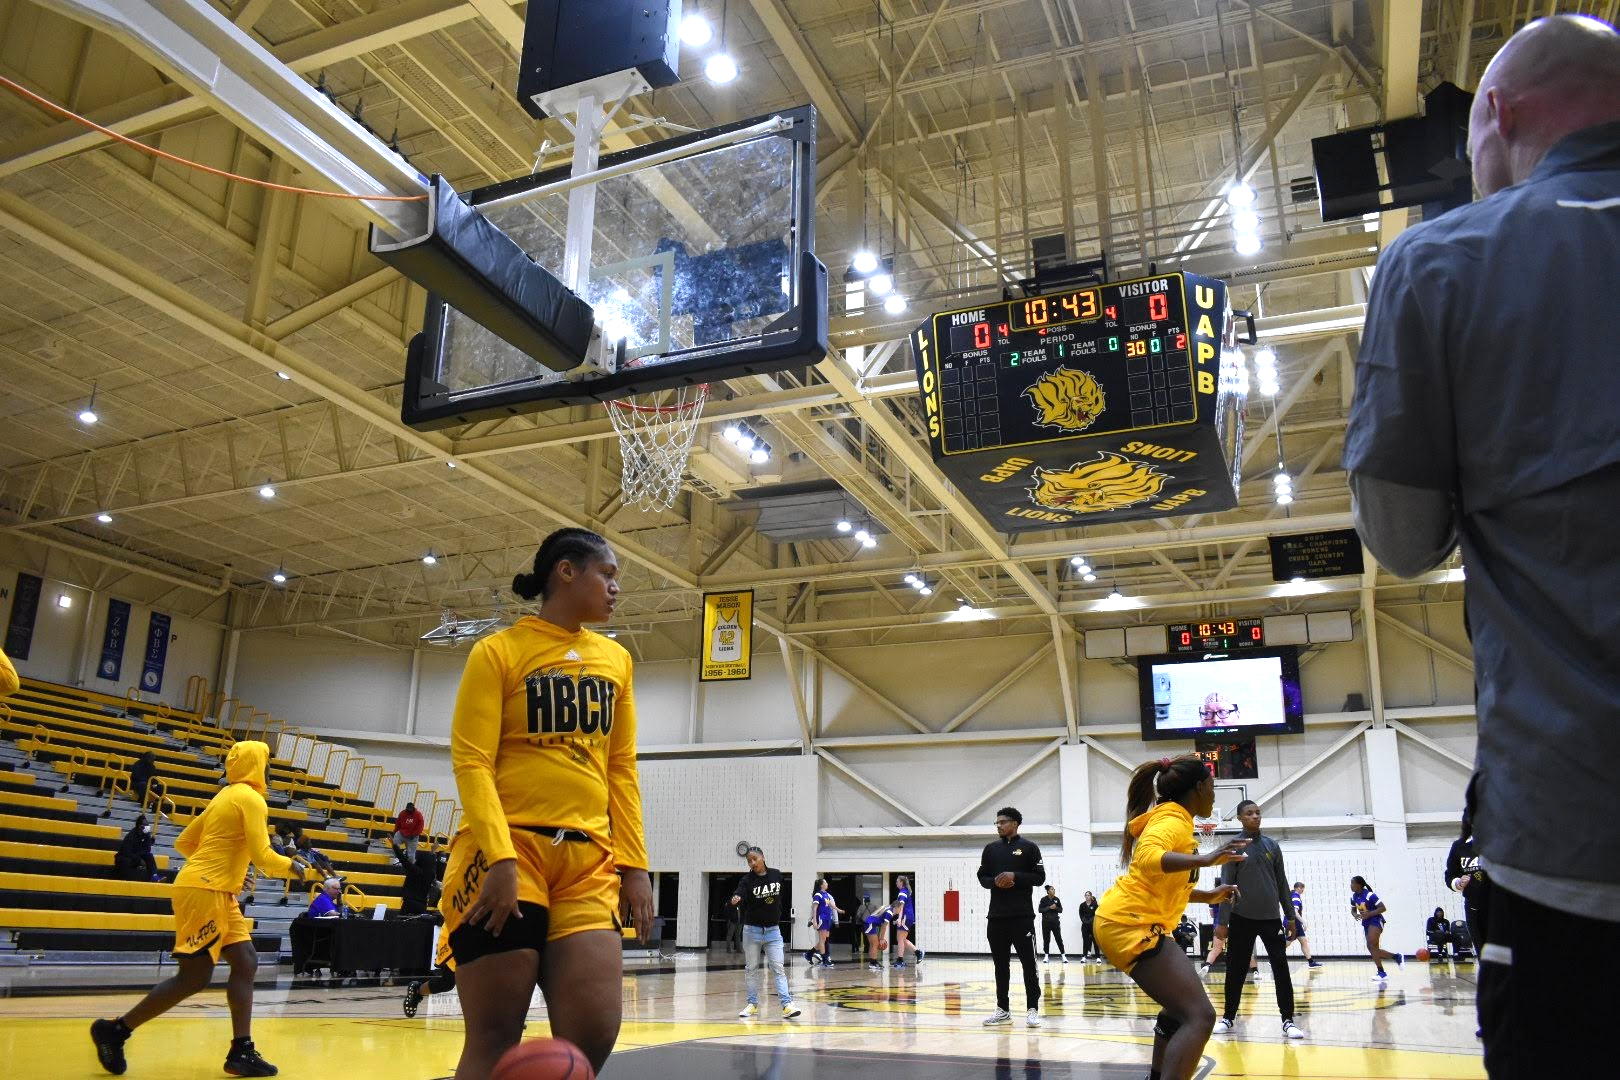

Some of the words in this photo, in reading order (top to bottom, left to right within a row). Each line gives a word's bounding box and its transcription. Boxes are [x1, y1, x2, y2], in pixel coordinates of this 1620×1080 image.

[1119, 279, 1169, 298] VISITOR
[1025, 291, 1097, 325] 10:43
[1105, 306, 1117, 320] 4
[1149, 293, 1168, 320] 0
[951, 309, 986, 326] HOME
[998, 323, 1009, 337] 4
[1046, 325, 1067, 334] POSS
[1129, 323, 1157, 332] BONUS
[1167, 327, 1180, 335] PTS
[974, 323, 991, 349] 0
[1040, 333, 1075, 345] PERIOD
[1176, 334, 1186, 350] 2
[1195, 285, 1215, 395] UAPB
[1058, 343, 1063, 357] 1
[1072, 341, 1095, 349] TEAM
[1108, 337, 1118, 351] 0
[1126, 340, 1146, 357] 30
[1150, 338, 1160, 353] 0
[962, 350, 988, 359] BONUS
[1023, 349, 1046, 357] TEAM
[1071, 347, 1097, 356] FOULS
[1010, 352, 1019, 366] 2
[1021, 355, 1047, 364] FOULS
[917, 329, 940, 438] LIONS
[1120, 441, 1198, 463] LIONS
[979, 457, 1035, 483] UAPB
[1150, 488, 1207, 511] UAPB
[1005, 507, 1073, 523] LIONS
[1314, 552, 1345, 560] COUNTRY
[1170, 624, 1188, 632] HOME
[1199, 622, 1235, 636] 10:43
[1238, 619, 1261, 627] VISITOR
[1181, 632, 1190, 645] 0
[1251, 627, 1261, 640] 0
[525, 676, 617, 737] HBCU
[752, 882, 781, 896] UAPB
